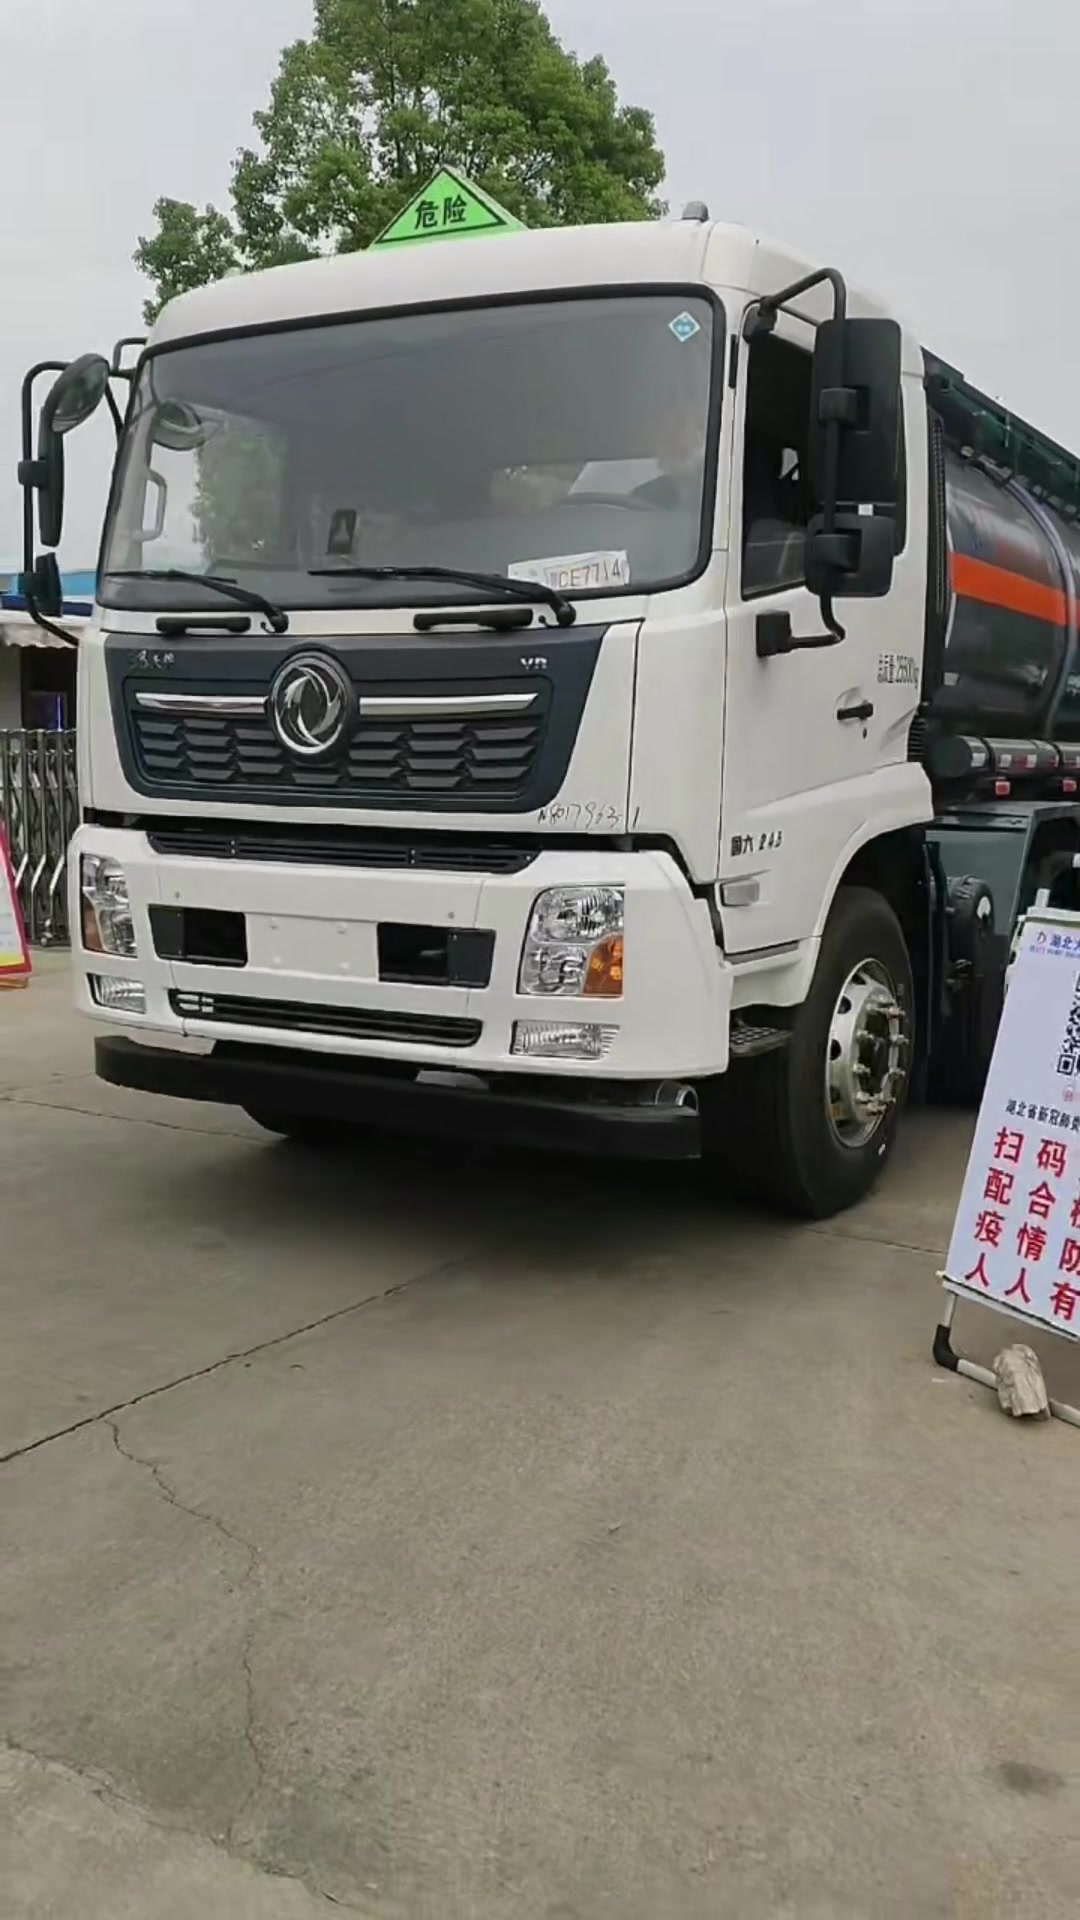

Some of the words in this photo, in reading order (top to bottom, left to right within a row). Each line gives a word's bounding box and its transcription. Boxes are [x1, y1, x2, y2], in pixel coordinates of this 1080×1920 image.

[415, 194, 467, 229] 危险
[994, 1126, 1067, 1178] 扫码
[965, 1252, 1080, 1321] 人人有
